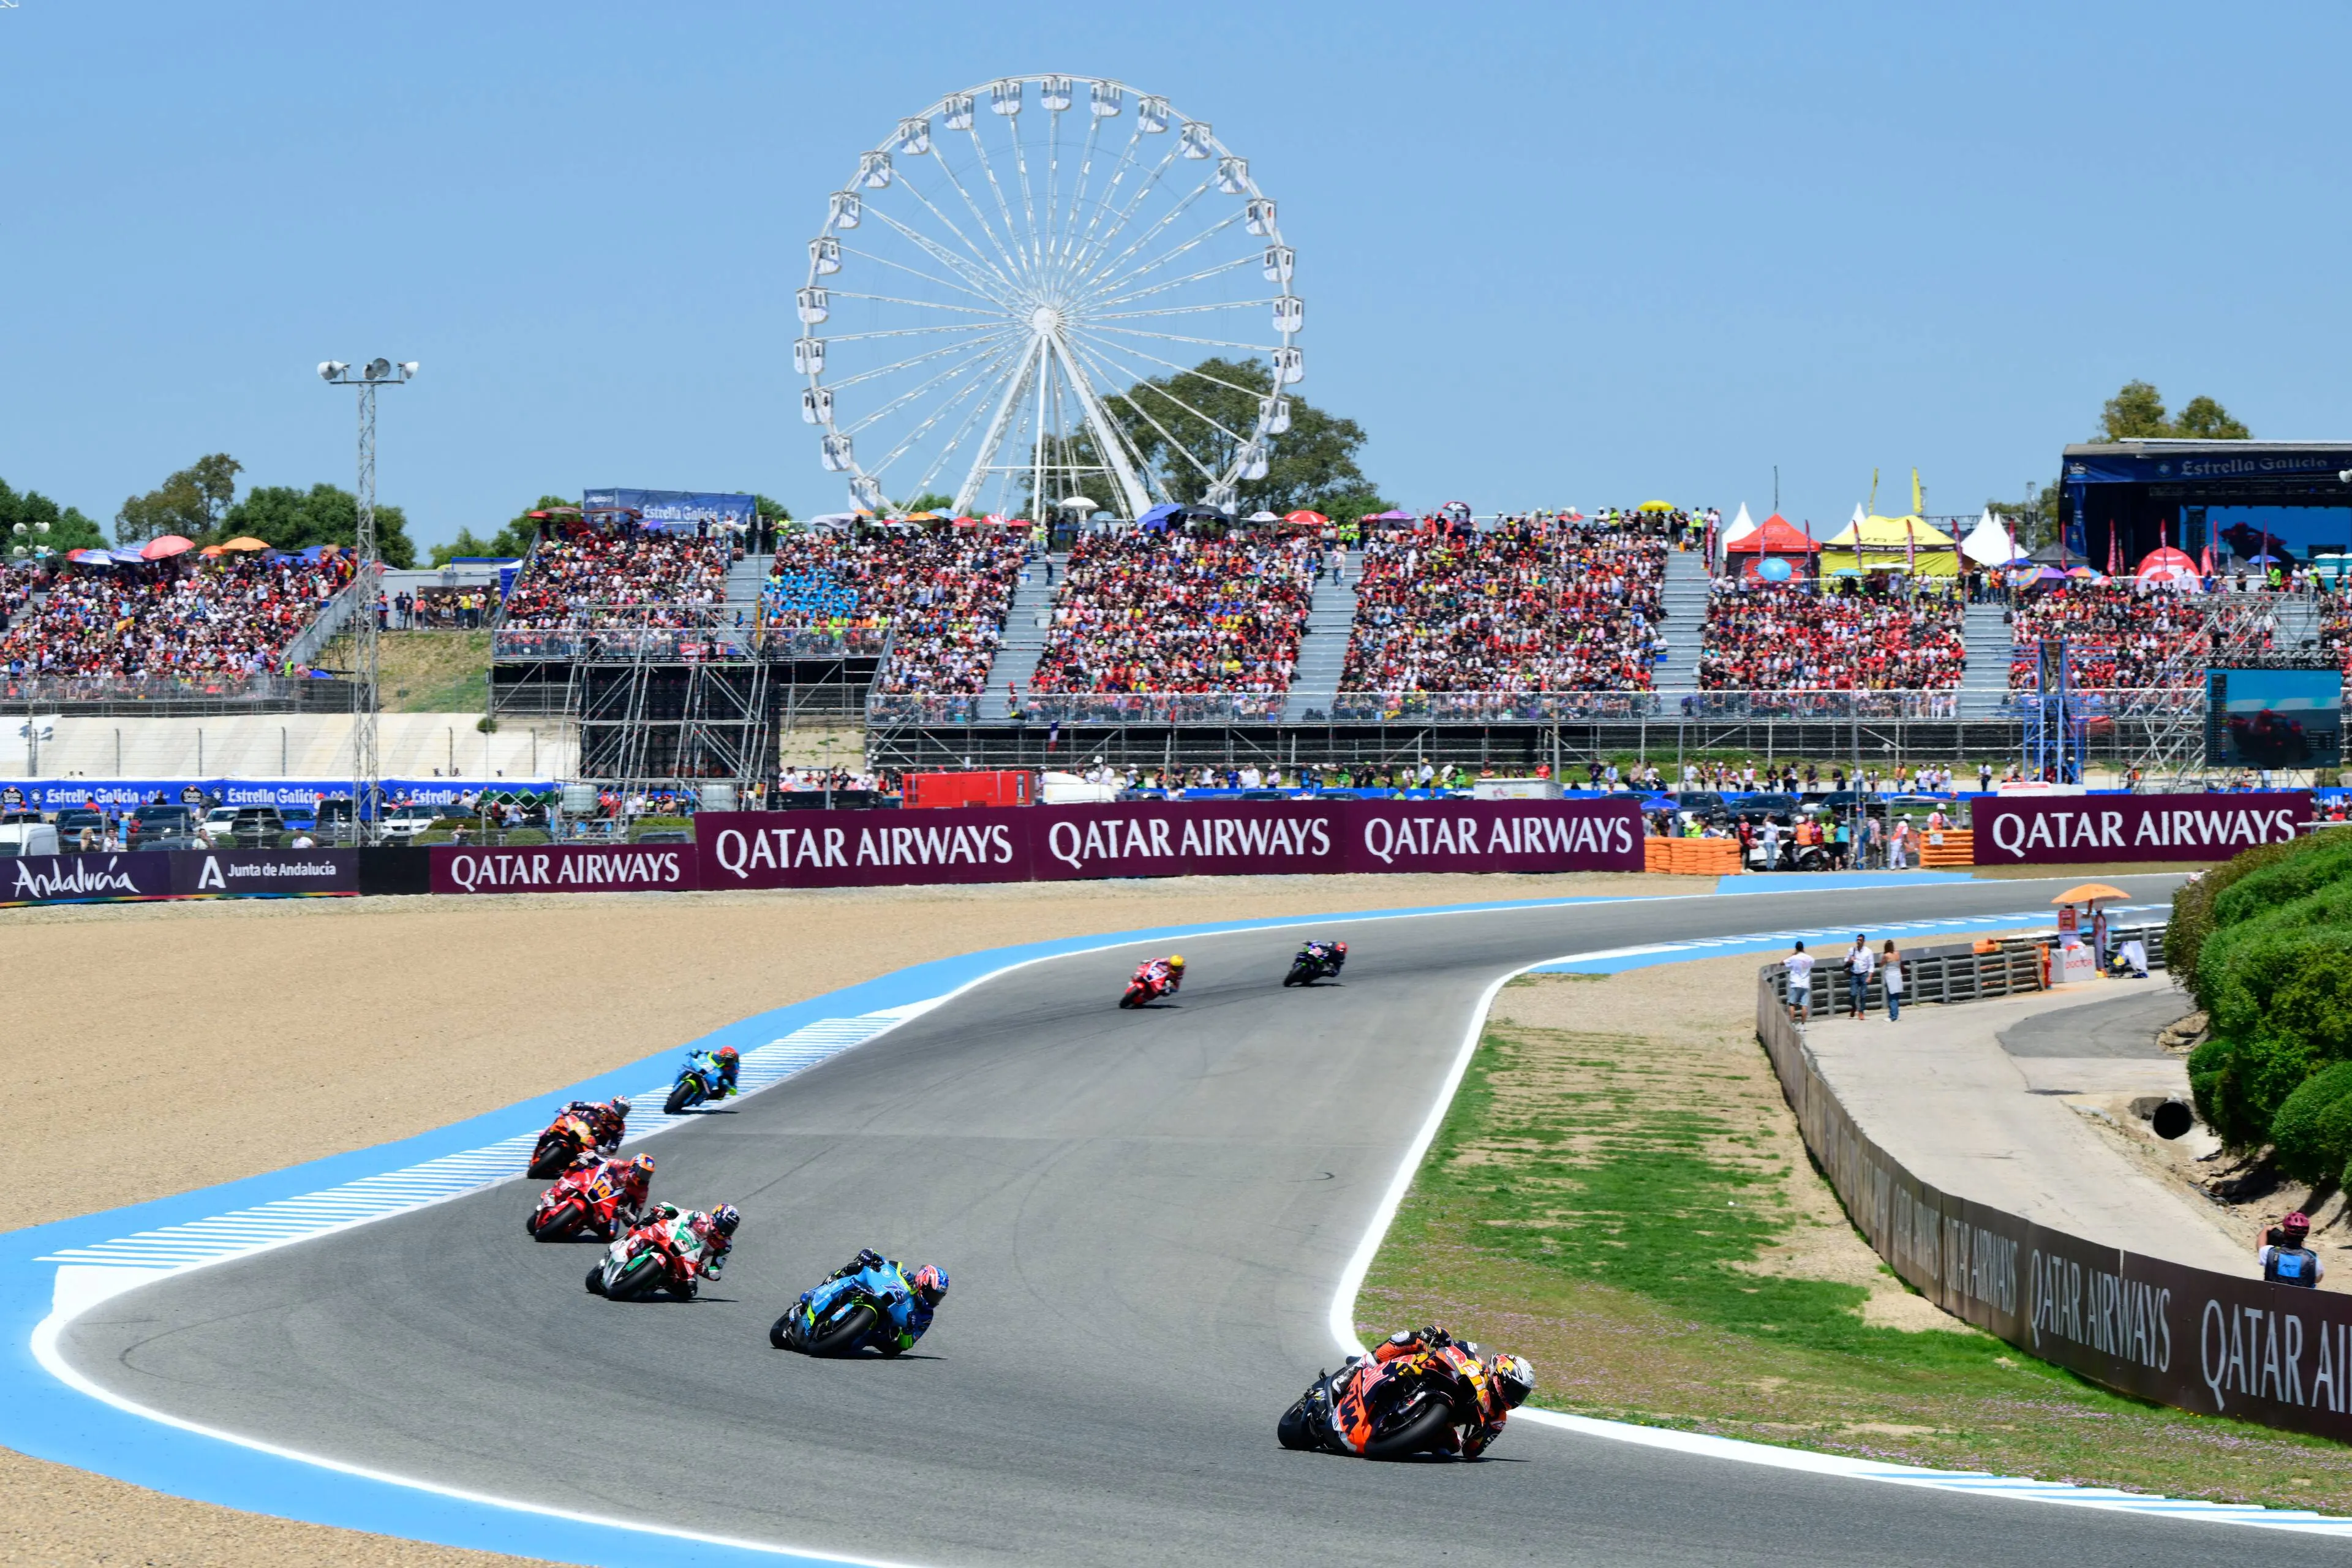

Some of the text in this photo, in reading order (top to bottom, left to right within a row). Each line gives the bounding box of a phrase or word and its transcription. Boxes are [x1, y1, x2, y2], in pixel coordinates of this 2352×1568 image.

[2180, 460, 2255, 476] Estrella
[643, 505, 682, 519] Estrella
[227, 788, 275, 803] Estrella
[717, 824, 1012, 879] QATAR AIRWAYS
[1049, 818, 1330, 869] QATAR AIRWAYS
[1365, 816, 1632, 864] QATAR AIRWAYS
[1992, 809, 2296, 858] QATAR AIRWAYS
[12, 856, 140, 899] Andalucía
[228, 861, 336, 877] Junta de Andalucía
[451, 852, 680, 892] QATAR AIRWAYS
[2065, 959, 2093, 969] DOCTOR
[592, 1180, 611, 1199] 10
[2030, 1249, 2170, 1373] QATAR AIRWAYS
[2202, 1299, 2352, 1414] QATAR AI
